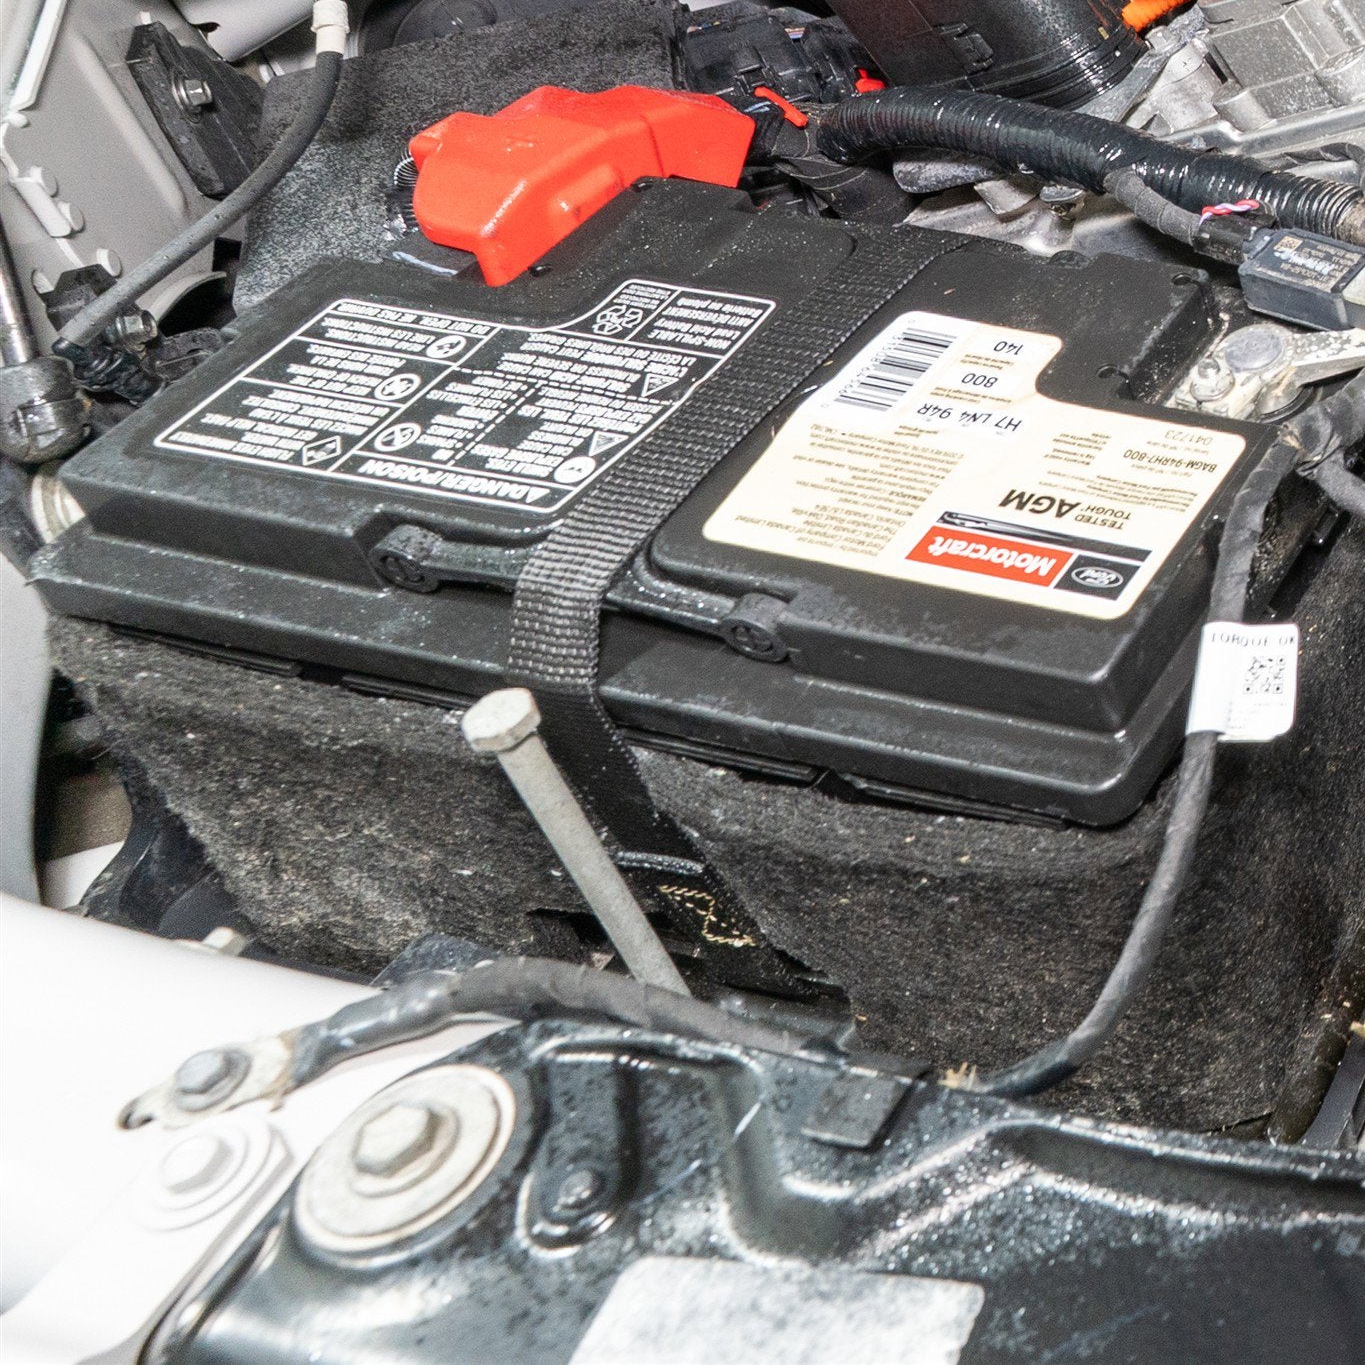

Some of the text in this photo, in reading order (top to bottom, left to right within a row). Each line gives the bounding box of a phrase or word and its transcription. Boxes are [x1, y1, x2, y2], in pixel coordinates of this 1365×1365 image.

[991, 340, 1025, 355] 140
[959, 371, 999, 388] 800
[915, 402, 1023, 431] H7 LN4 94R
[1162, 429, 1213, 446] 041723
[1121, 447, 1218, 474] BAGM-94RH7-800
[355, 458, 533, 500] DANGER/POISON
[998, 488, 1081, 519] AGM
[1072, 512, 1127, 530] TESTED
[922, 533, 1058, 577] Motorcraft
[1074, 565, 1120, 587] Ford
